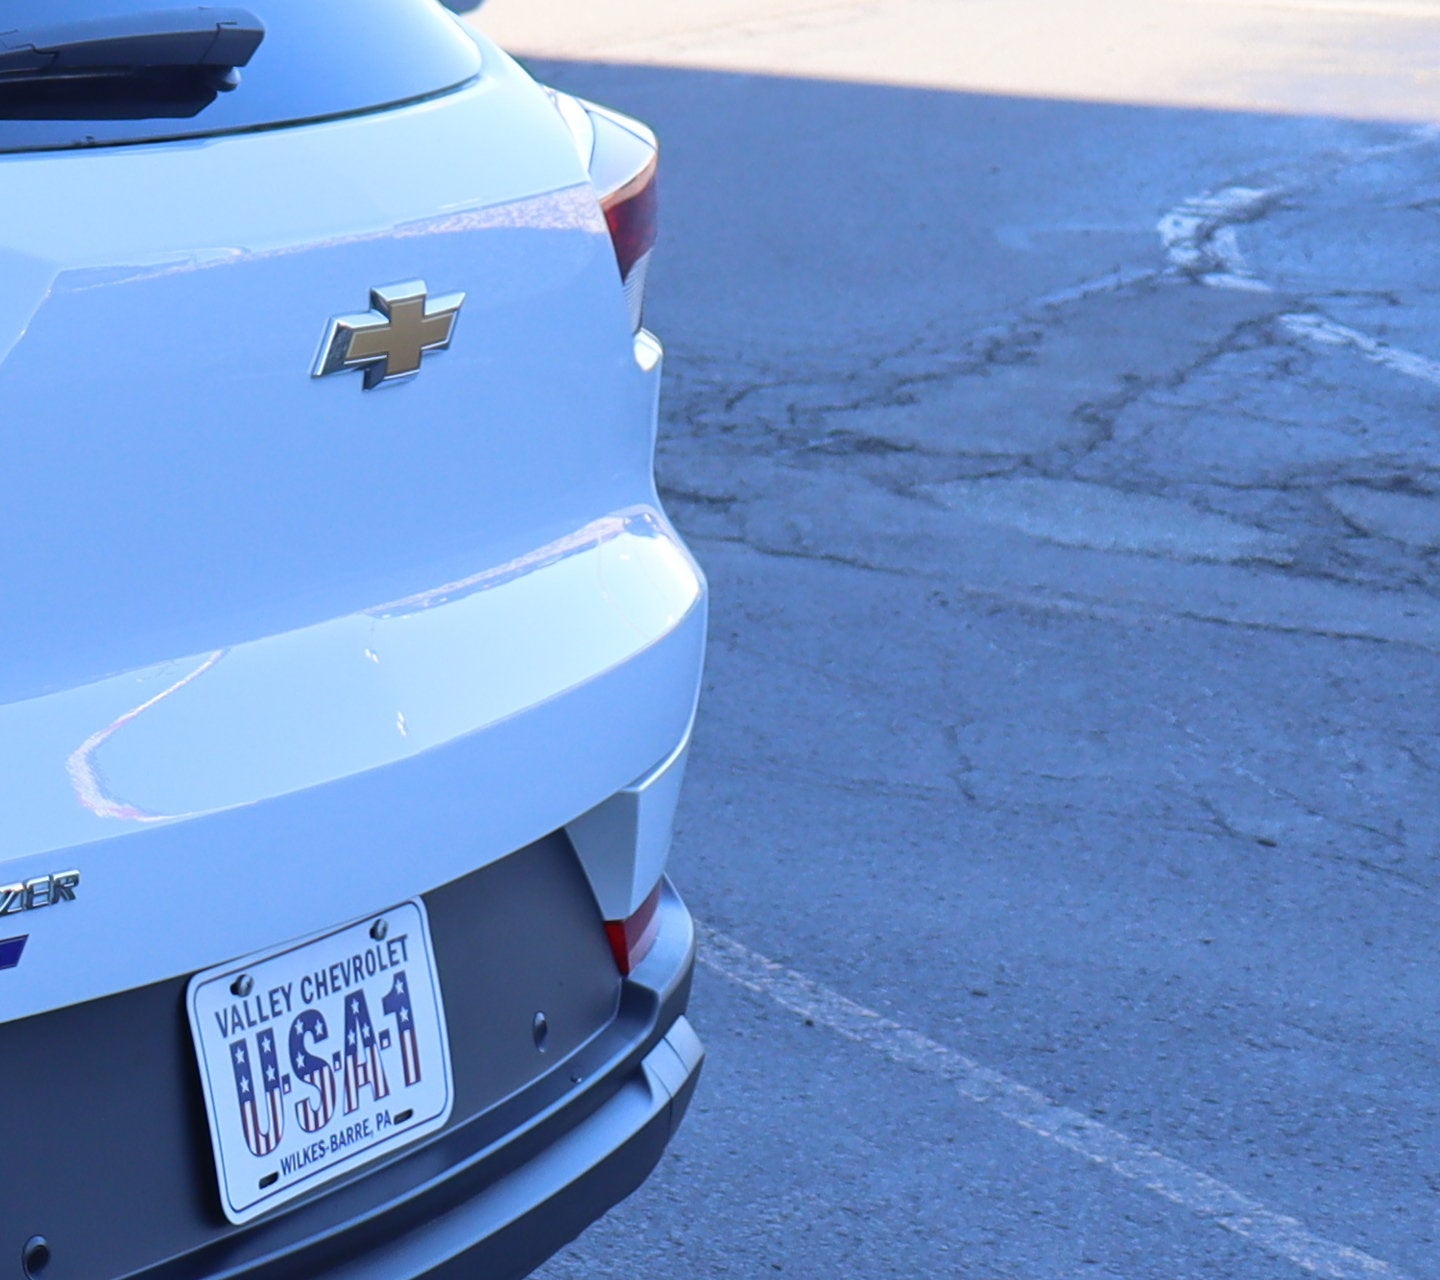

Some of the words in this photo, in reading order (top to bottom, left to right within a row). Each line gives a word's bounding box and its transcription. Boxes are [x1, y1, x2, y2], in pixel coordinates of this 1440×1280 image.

[215, 981, 293, 1039] VALLEY
[300, 934, 409, 1005] CHEVROLET
[280, 1119, 374, 1177] WILKES-BARRE,
[376, 1109, 393, 1133] PA
